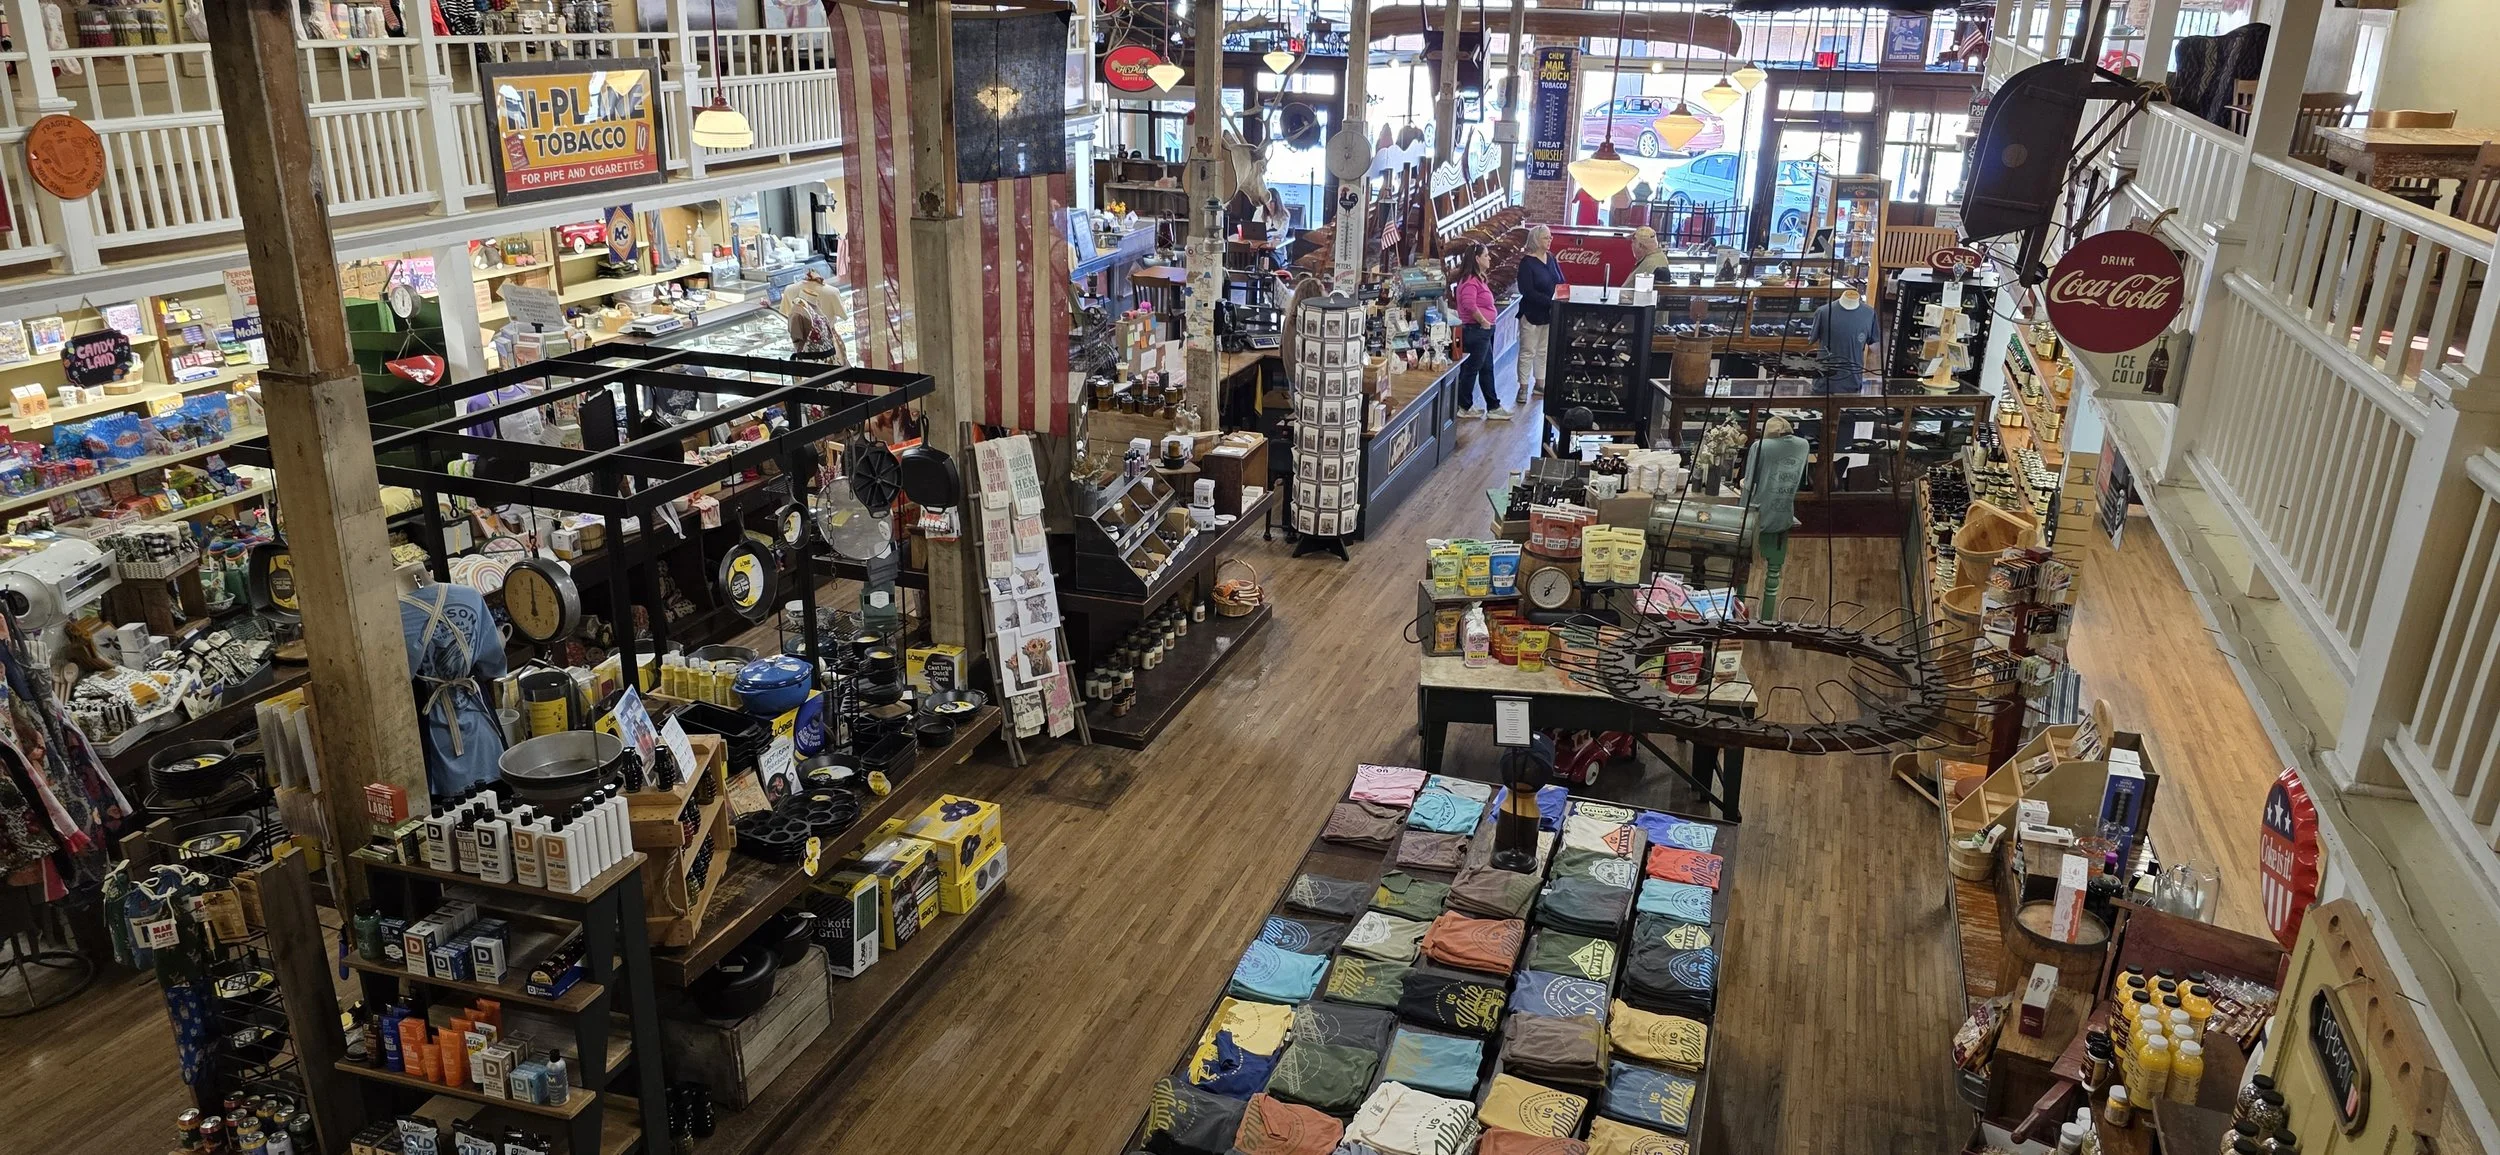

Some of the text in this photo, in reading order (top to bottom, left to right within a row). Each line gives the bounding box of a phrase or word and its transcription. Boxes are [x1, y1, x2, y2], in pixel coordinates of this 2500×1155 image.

[1548, 52, 1565, 60] CHEW
[1545, 61, 1565, 71] MAIL
[1540, 71, 1569, 81] POUCH
[504, 84, 646, 131] HI-PLNE
[42, 119, 74, 134] FRAGILE
[533, 126, 627, 157] TOBACCO
[1533, 149, 1563, 161] YOURSELF
[521, 159, 645, 185] FOR PIPE AND CIGARETTES
[1556, 249, 1601, 265] Coca-Cola
[1931, 250, 1976, 268] CASE
[2101, 255, 2136, 267] DRINK
[1335, 262, 1352, 270] PETERS
[226, 270, 251, 279] PERFOR
[231, 278, 253, 287] SECON
[2051, 269, 2181, 310] Coca-Cola
[237, 286, 255, 294] NON
[247, 318, 262, 326] NE
[76, 338, 116, 360] CANDY
[86, 353, 117, 370] LAND
[2114, 354, 2137, 369] ICE
[2111, 369, 2145, 385] COLD
[446, 609, 476, 625] SON
[367, 800, 395, 819] LARGE
[430, 826, 439, 838] D
[480, 832, 493, 846] D
[517, 835, 529, 849] D
[548, 841, 560, 855] D
[1618, 824, 1631, 858] WHITE
[2261, 833, 2295, 882] Coke is it!
[1691, 855, 1713, 886] White
[152, 924, 172, 935] MAN
[154, 931, 174, 940] PARTS
[818, 928, 844, 939] Grill
[1673, 933, 1683, 943] UG
[1684, 924, 1698, 950] HITE
[409, 940, 421, 952] D
[477, 948, 490, 962] D
[1580, 954, 1590, 964] UG
[1588, 940, 1605, 978] WHITE
[436, 957, 446, 969] D
[1689, 962, 1698, 973] UG
[1445, 993, 1457, 1005] UG
[1455, 984, 1485, 1029] White
[1669, 1032, 1678, 1046] UG
[1679, 1023, 1702, 1062] White
[2318, 1001, 2355, 1093] POPCORN
[486, 1062, 498, 1076] D
[1153, 1078, 1177, 1131] White
[1648, 1091, 1661, 1104] UG
[1660, 1080, 1688, 1126] White
[1177, 1099, 1188, 1114] UG
[1542, 1107, 1554, 1119] UG
[1426, 1117, 1441, 1130] UG
[1551, 1095, 1582, 1138] White
[1434, 1103, 1473, 1155] White
